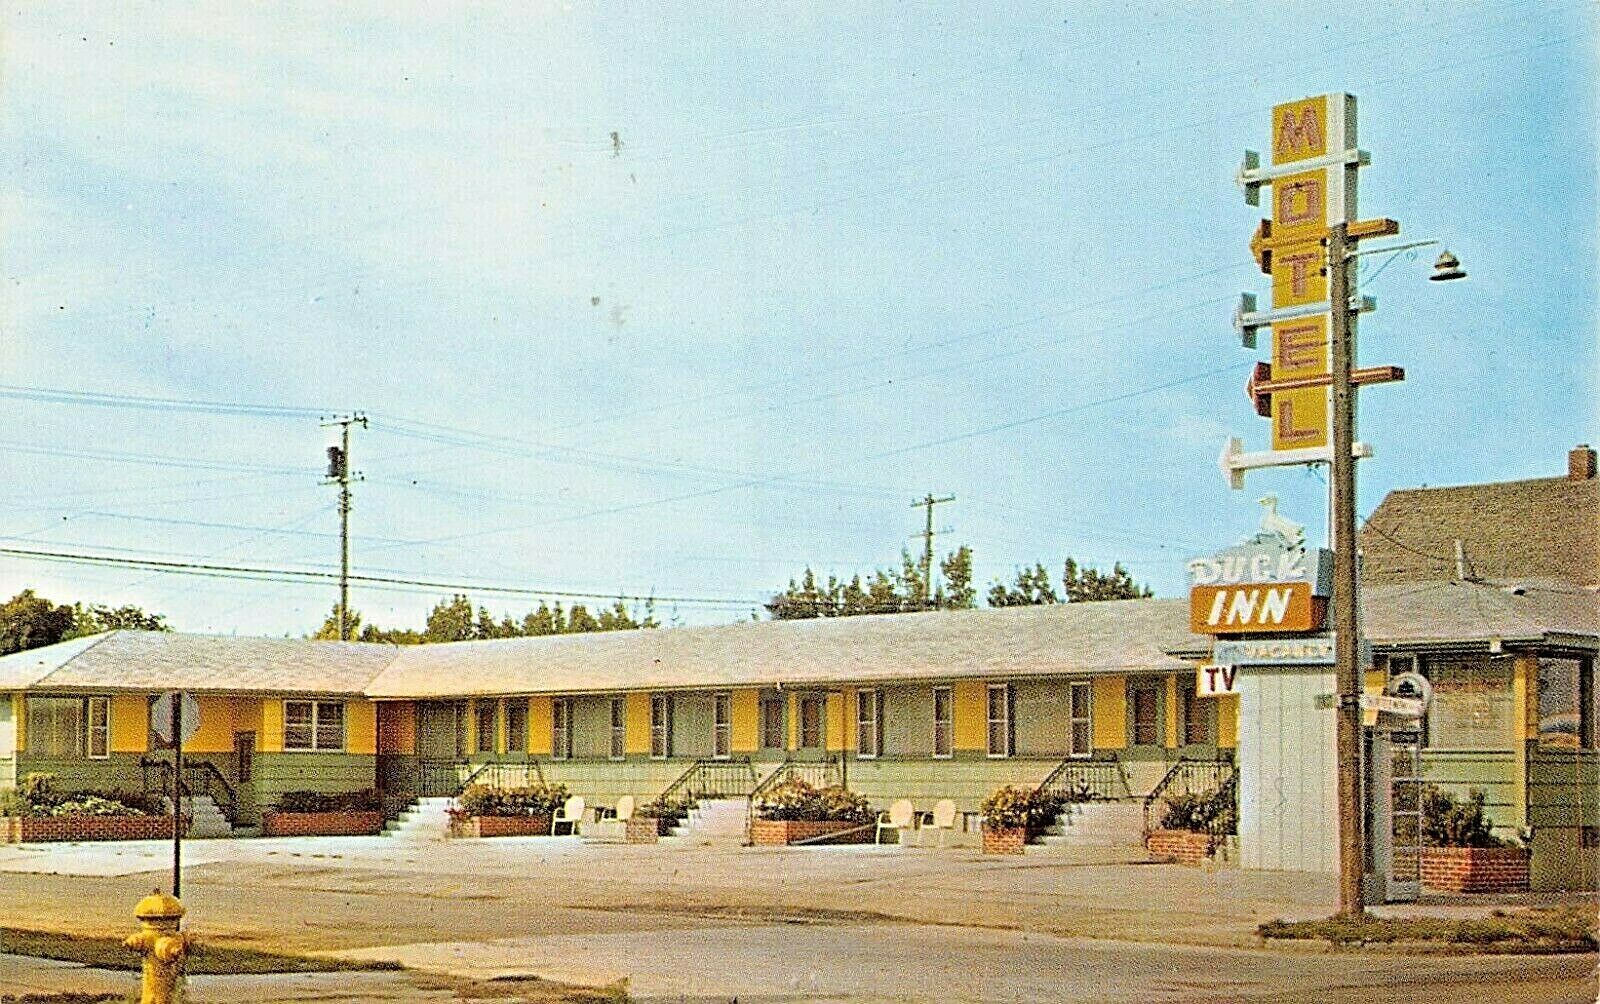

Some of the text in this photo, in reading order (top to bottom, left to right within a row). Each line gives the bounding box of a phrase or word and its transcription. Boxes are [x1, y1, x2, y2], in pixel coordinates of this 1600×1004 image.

[1275, 105, 1322, 440] MOTEL
[1186, 551, 1306, 584] DUCK
[1207, 588, 1293, 626] INN
[1204, 665, 1237, 692] TV
